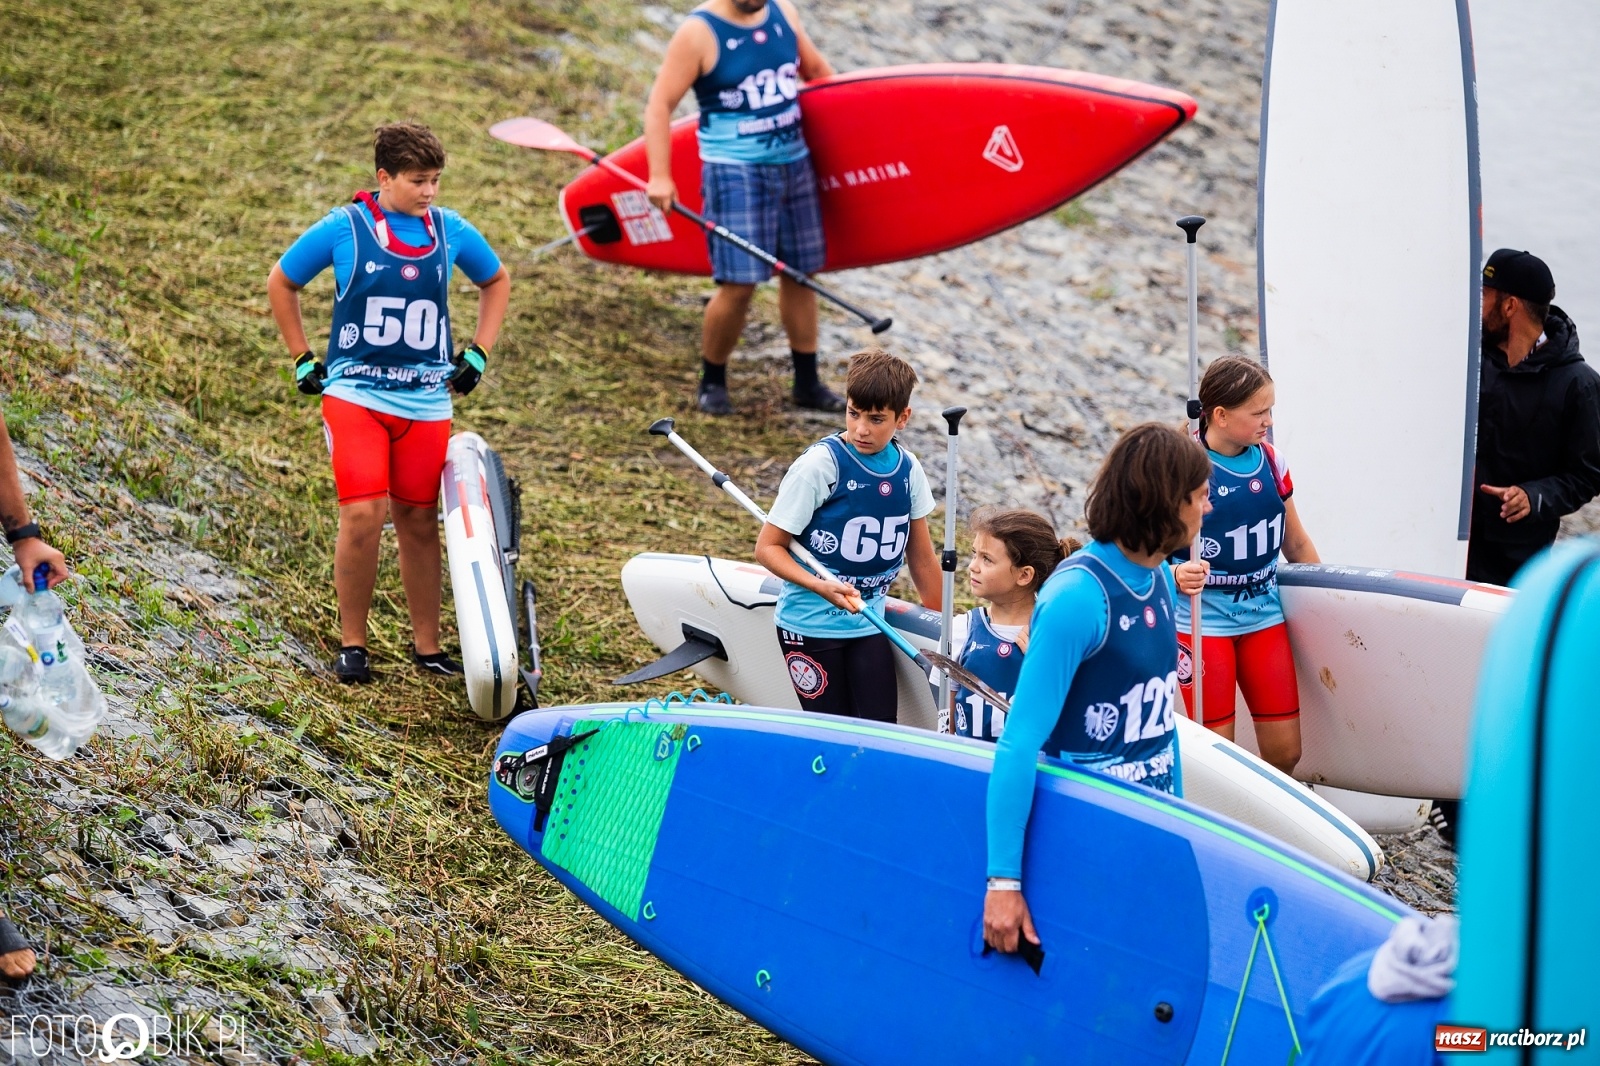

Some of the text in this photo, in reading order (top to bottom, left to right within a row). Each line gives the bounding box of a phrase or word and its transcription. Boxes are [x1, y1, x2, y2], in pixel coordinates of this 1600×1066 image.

[844, 161, 911, 186] MARINA
[363, 296, 439, 350] 50
[387, 366, 418, 383] SUP
[420, 370, 446, 384] CUP
[840, 513, 909, 563] 65
[1225, 512, 1283, 560] 111
[861, 574, 885, 588] SUP
[1206, 574, 1248, 586] ODRA
[1252, 565, 1272, 583] SUP
[1226, 610, 1248, 618] AQUA
[966, 692, 1013, 738] 11
[1120, 671, 1177, 743] 128
